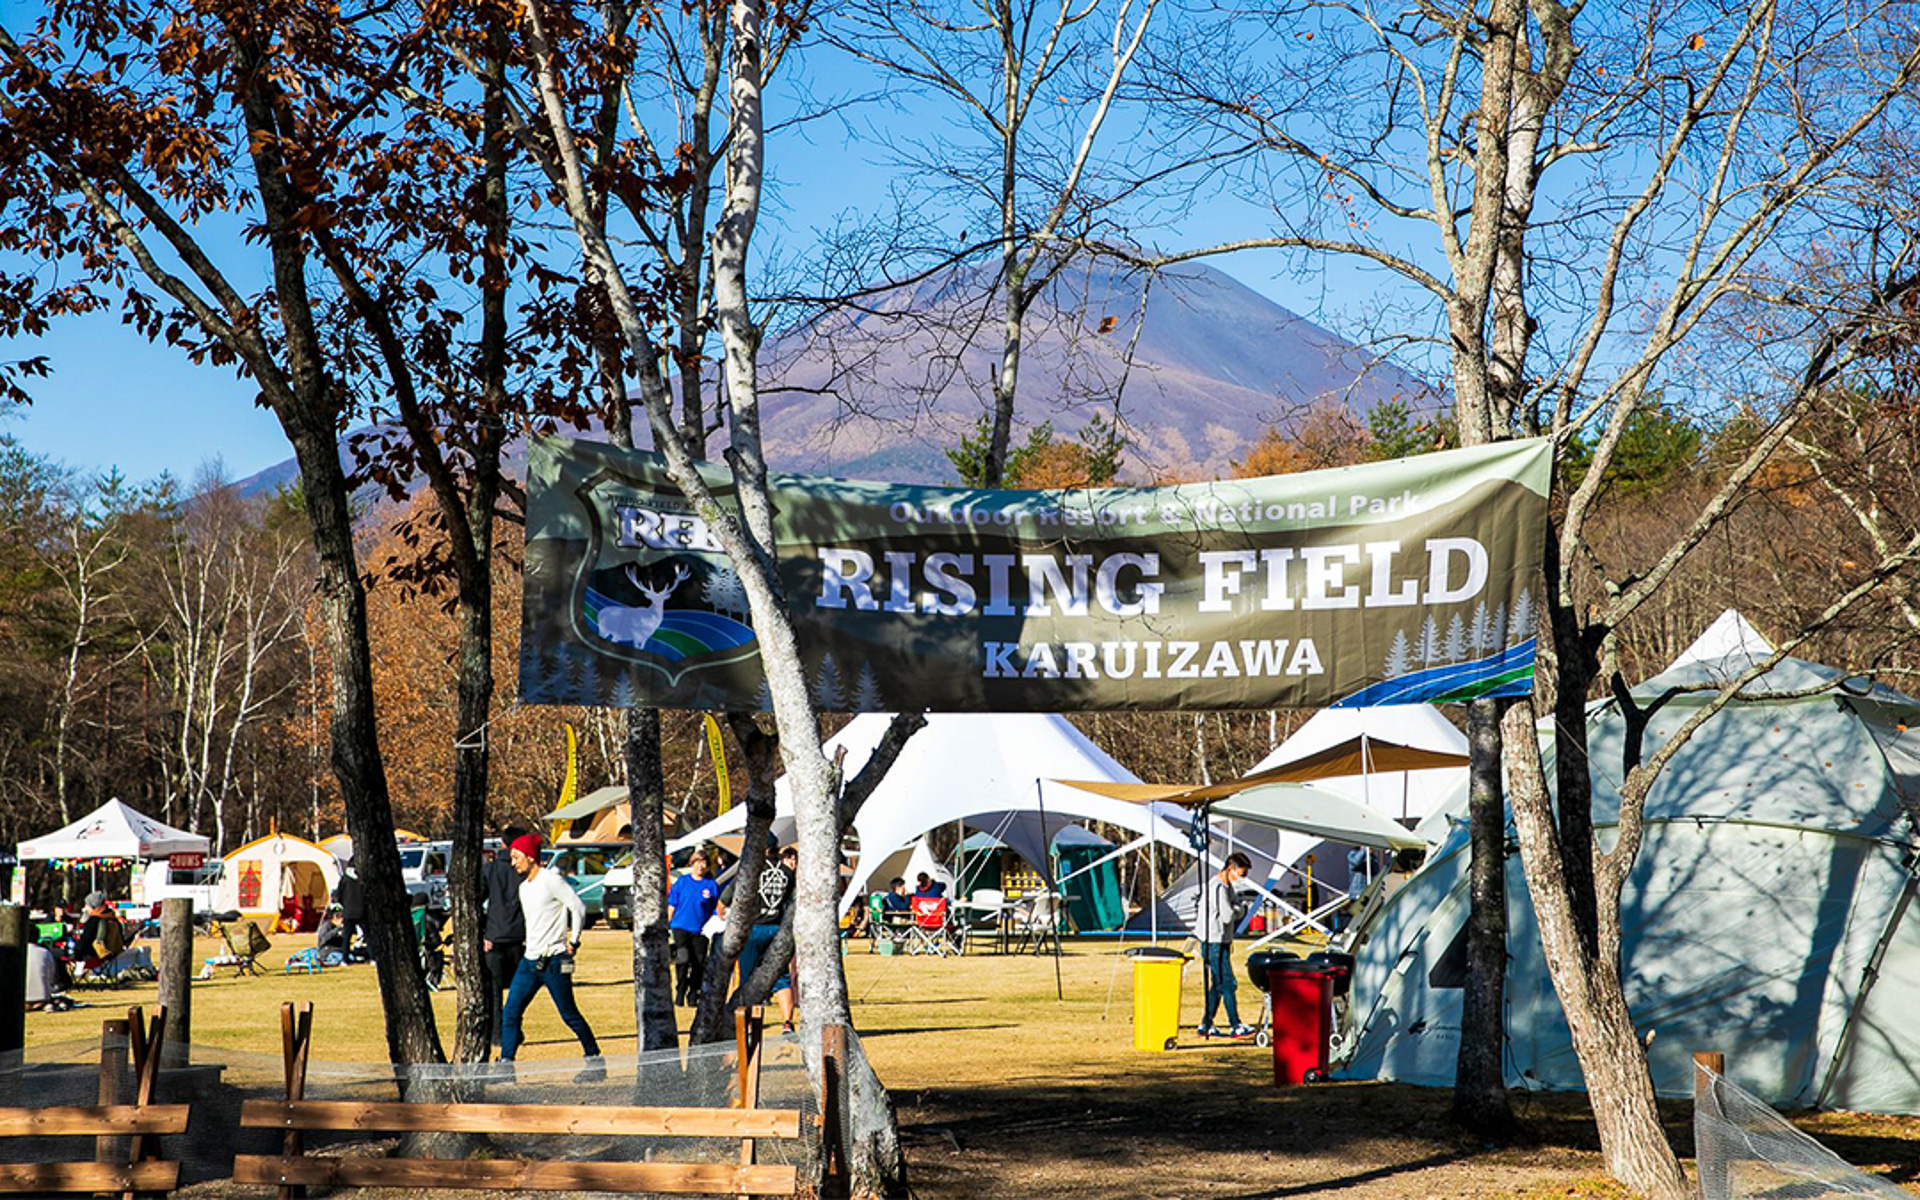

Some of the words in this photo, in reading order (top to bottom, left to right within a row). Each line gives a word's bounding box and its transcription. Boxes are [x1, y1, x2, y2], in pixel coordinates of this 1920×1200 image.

[889, 501, 1024, 525] Outdoor
[1039, 505, 1146, 526] Resort
[1159, 503, 1182, 524] &
[1195, 494, 1336, 524] National
[1348, 490, 1421, 516] Park
[815, 547, 1165, 617] RISING
[1197, 537, 1489, 613] FIELD
[982, 638, 1324, 680] KARUIZAWA
